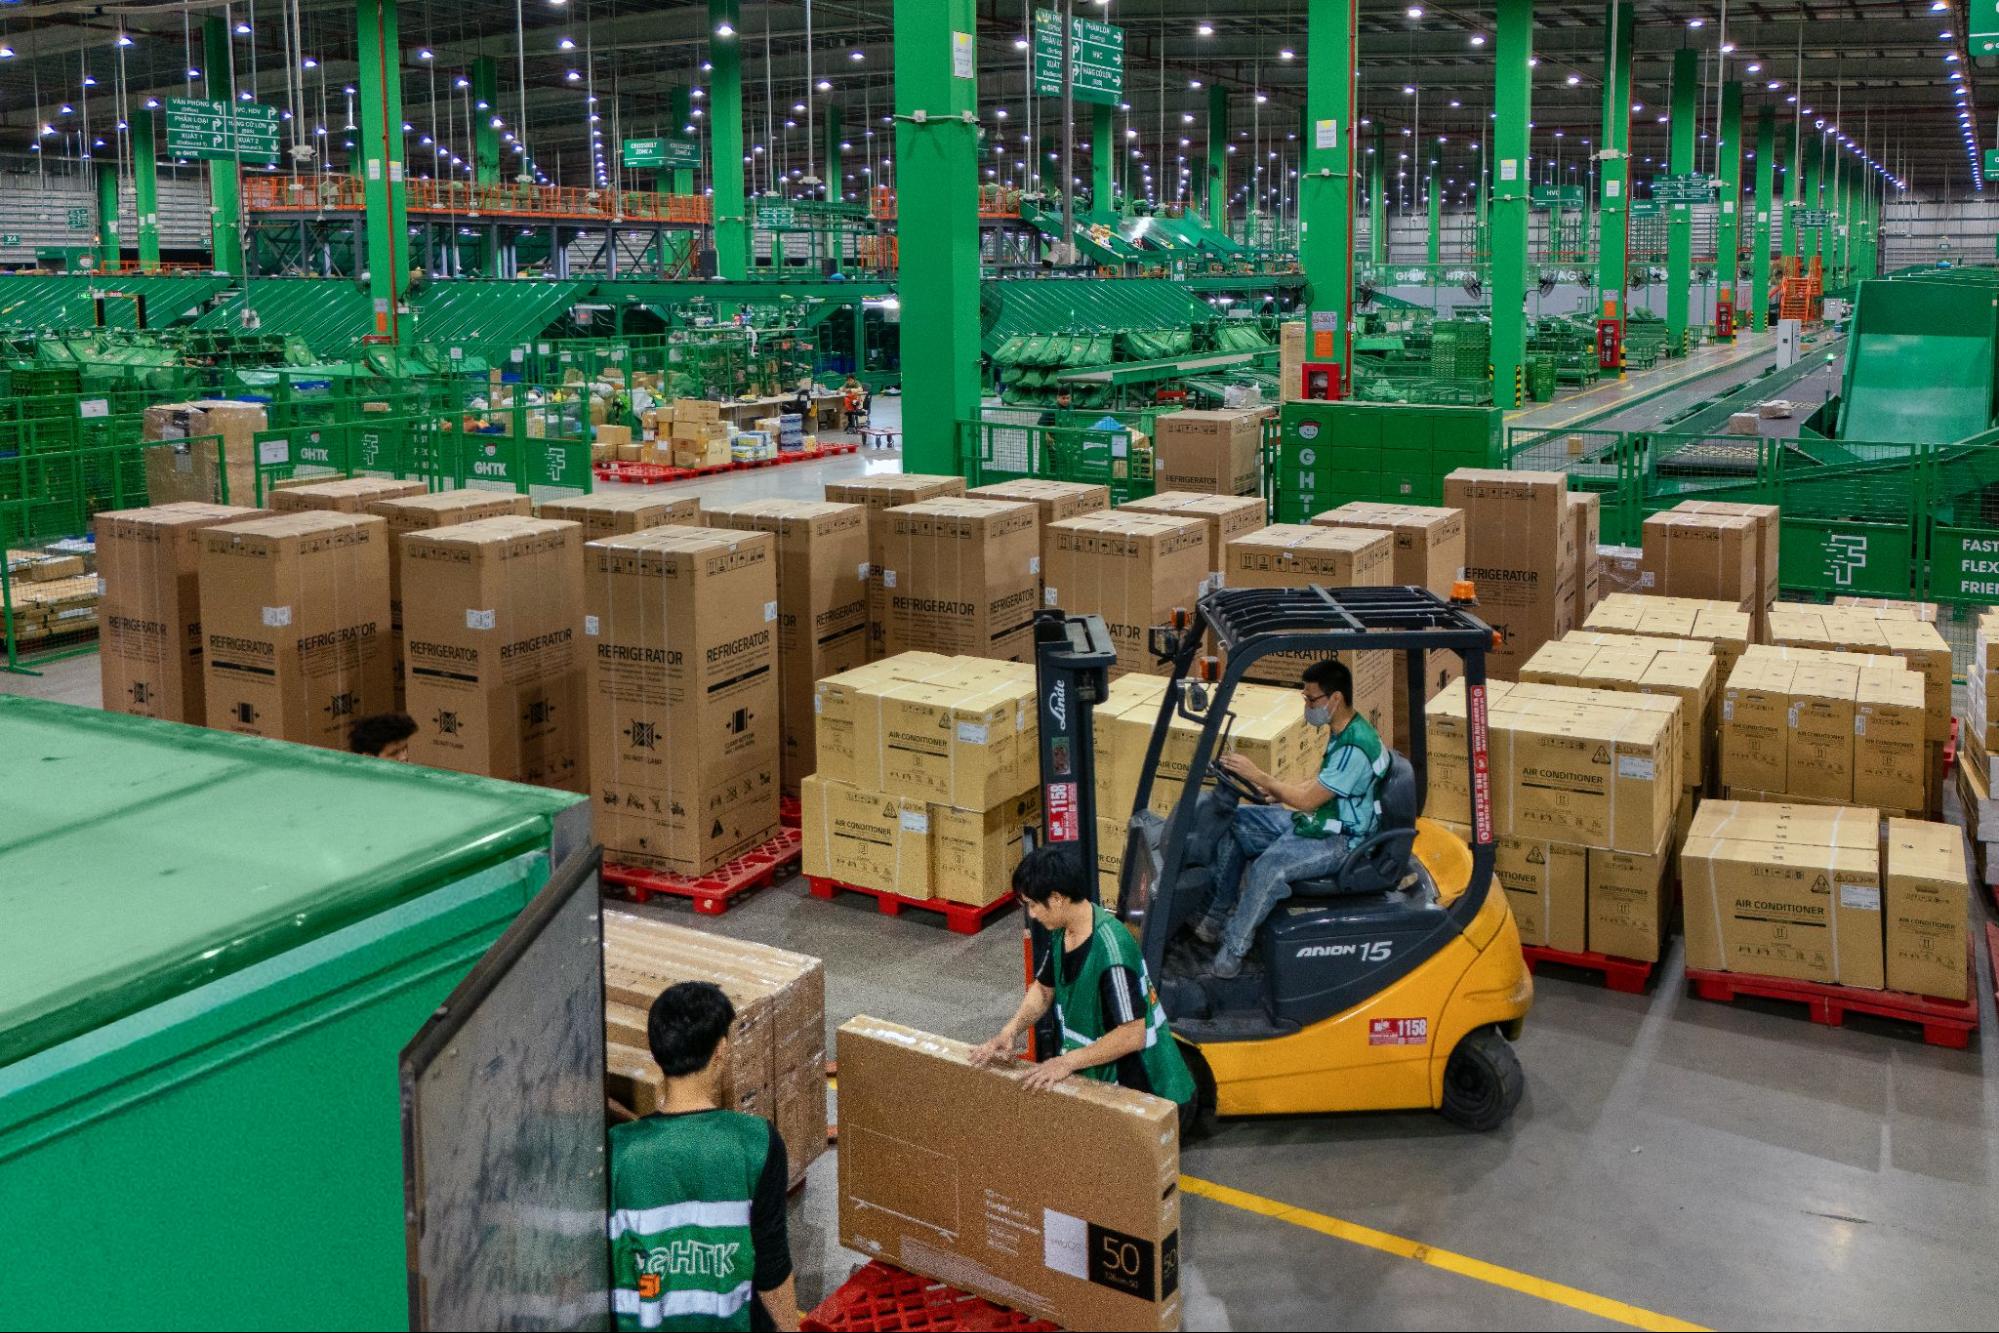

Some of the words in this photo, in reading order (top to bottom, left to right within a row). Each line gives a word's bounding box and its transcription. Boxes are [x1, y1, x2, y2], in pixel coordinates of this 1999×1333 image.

[6, 235, 18, 243] X4
[301, 447, 329, 462] GHTK
[474, 461, 507, 476] GHTK
[1962, 538, 1999, 553] FAST
[1464, 567, 1538, 582] EFRIGERATOR
[816, 602, 865, 626] REFRIGERATOR
[893, 596, 975, 616] REFRIGERATOR
[109, 616, 167, 636] REFRIGERATOR
[210, 635, 274, 656] REFRIGERATOR
[410, 641, 478, 663] REFRIGERATOR
[501, 628, 572, 660] REFRIGERATOR
[598, 643, 682, 665] REFRIGERATOR
[707, 630, 769, 663] REFRIGERATOR
[1050, 680, 1065, 730] Linde
[889, 730, 900, 739] AIR
[901, 733, 947, 747] CONDITIONER
[1522, 768, 1538, 776] AIR
[1540, 769, 1603, 783] CONDITIONER
[1051, 784, 1068, 813] 1158
[834, 818, 846, 827] AIR
[847, 822, 892, 835] CONDITIONER
[1735, 899, 1752, 909] AIR
[1754, 901, 1824, 916] CONDITIONER
[1360, 940, 1393, 962] 15
[1398, 1019, 1427, 1037] 1158
[1103, 1236, 1140, 1275] 50
